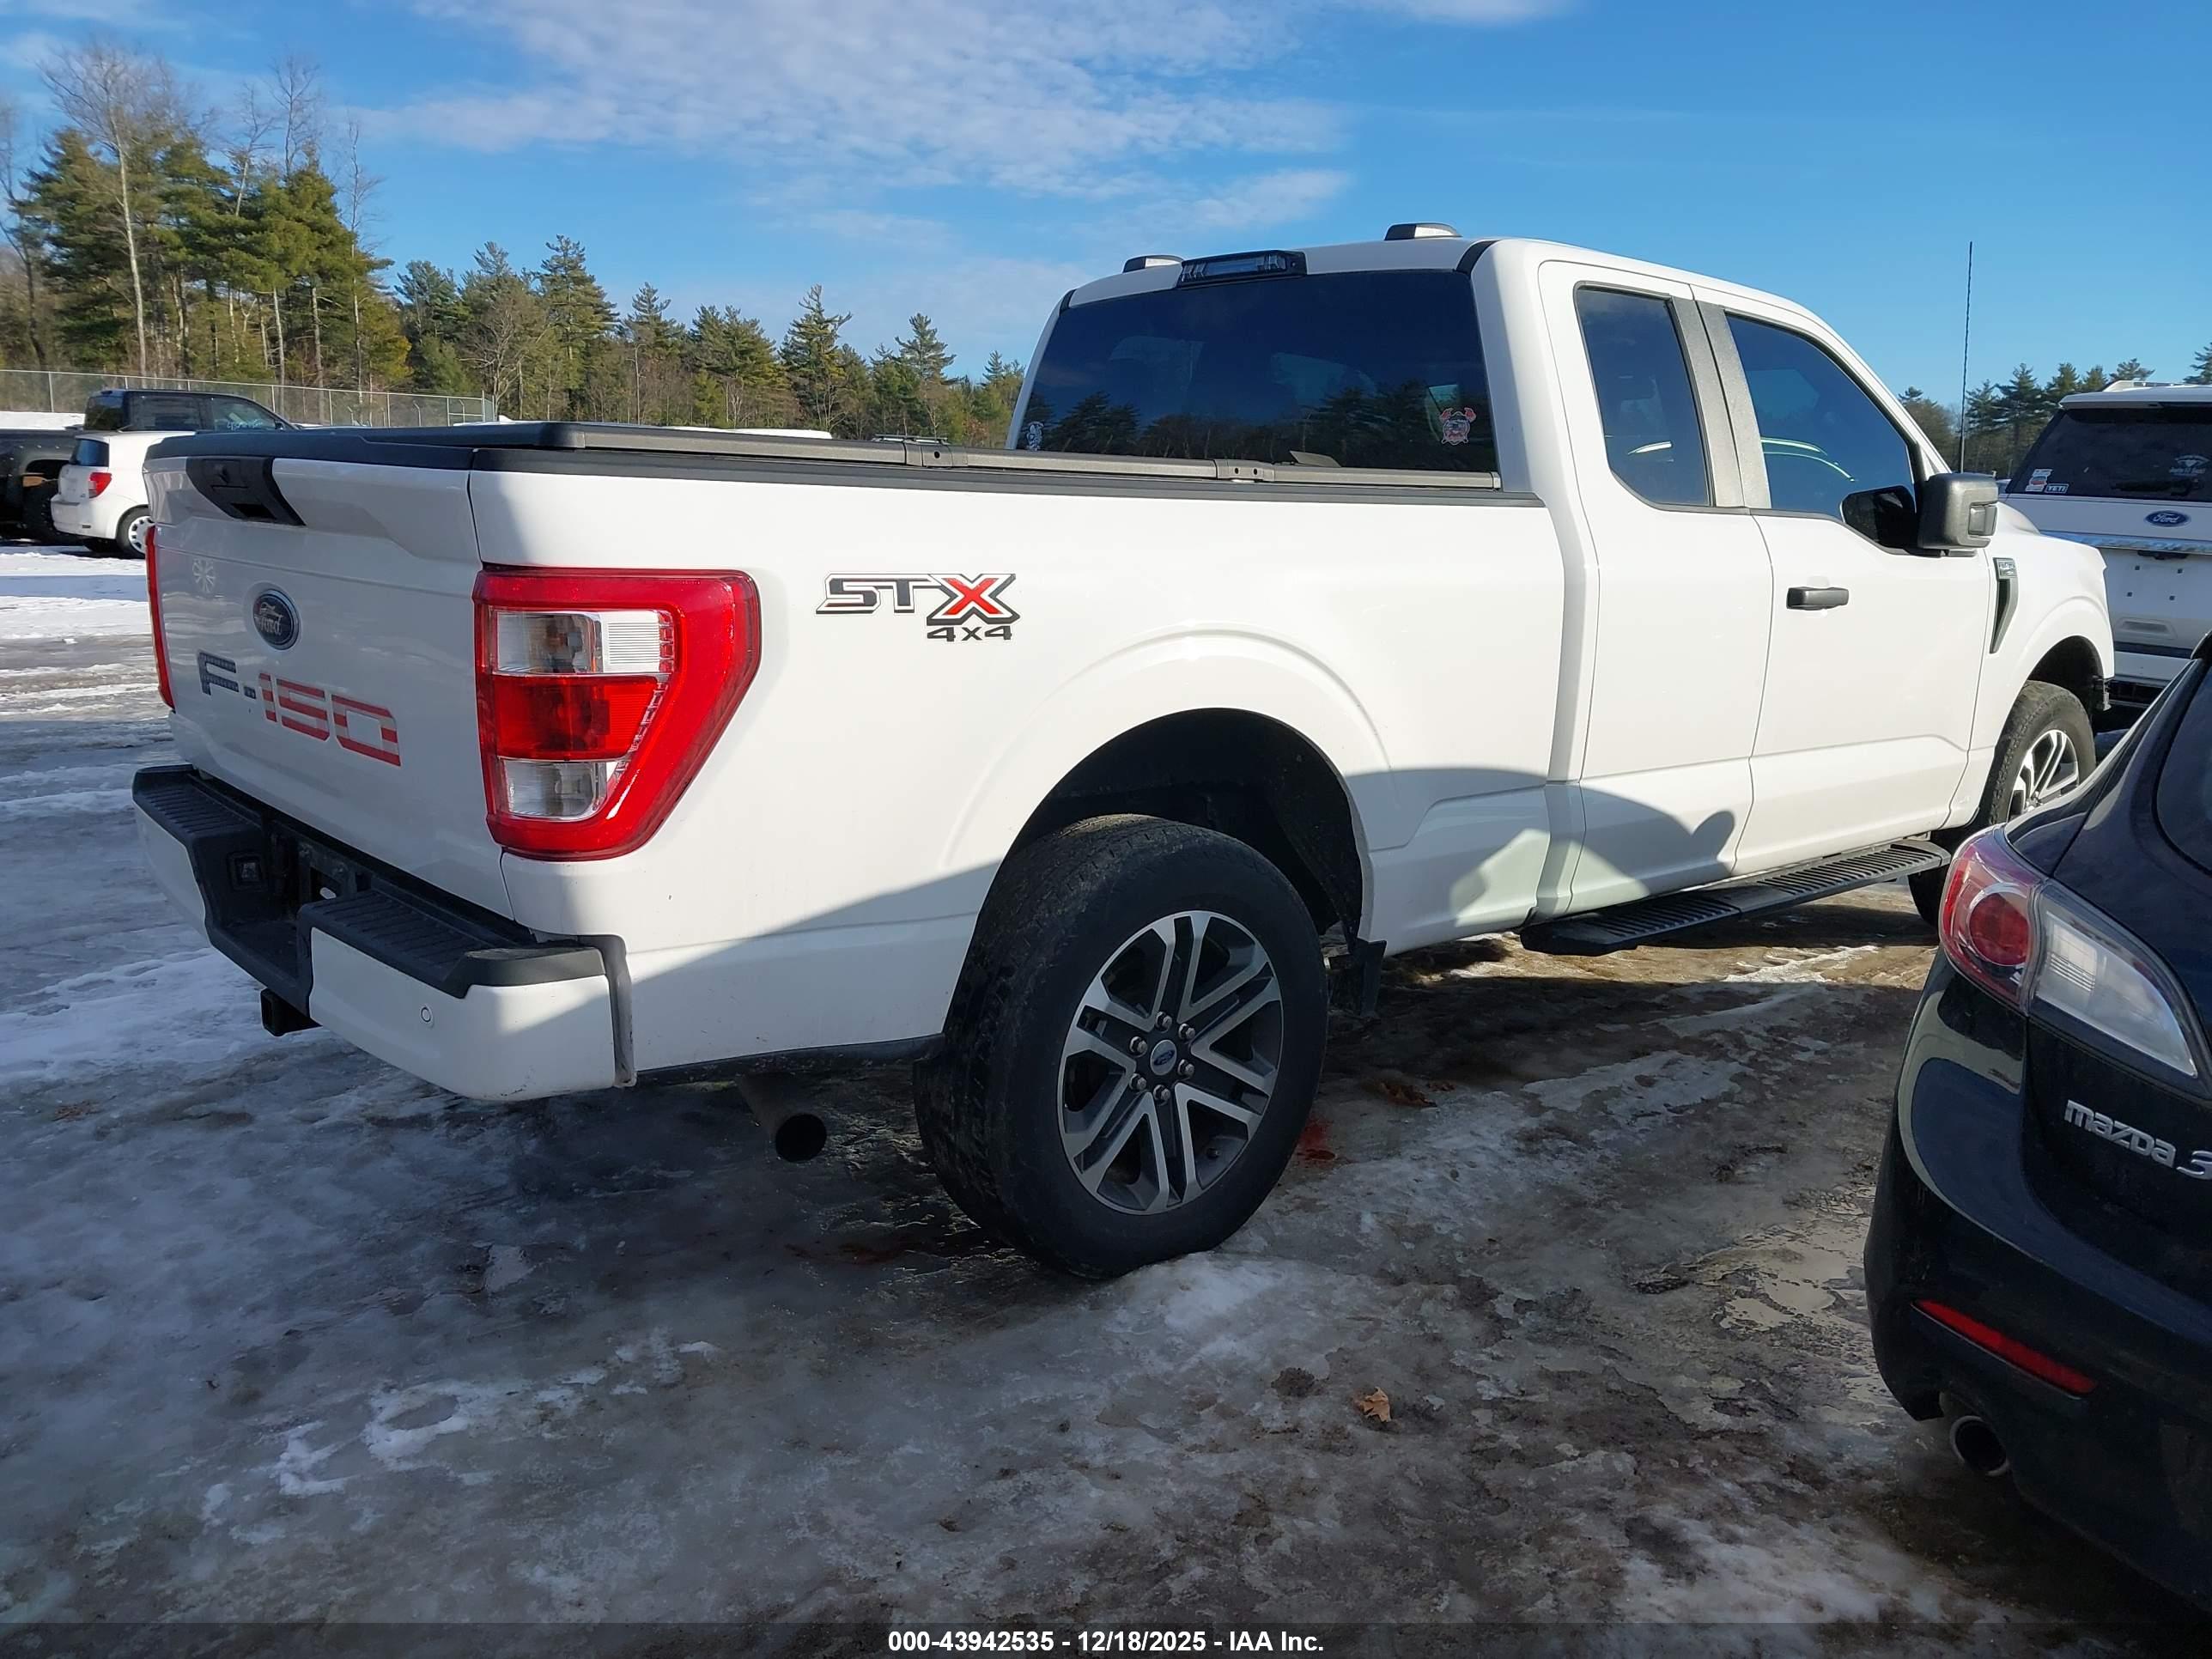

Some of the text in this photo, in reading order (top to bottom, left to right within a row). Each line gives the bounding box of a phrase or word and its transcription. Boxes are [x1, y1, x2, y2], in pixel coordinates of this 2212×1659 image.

[2153, 513, 2179, 523] Ford
[816, 573, 1020, 625] STX
[198, 651, 401, 767] F-150
